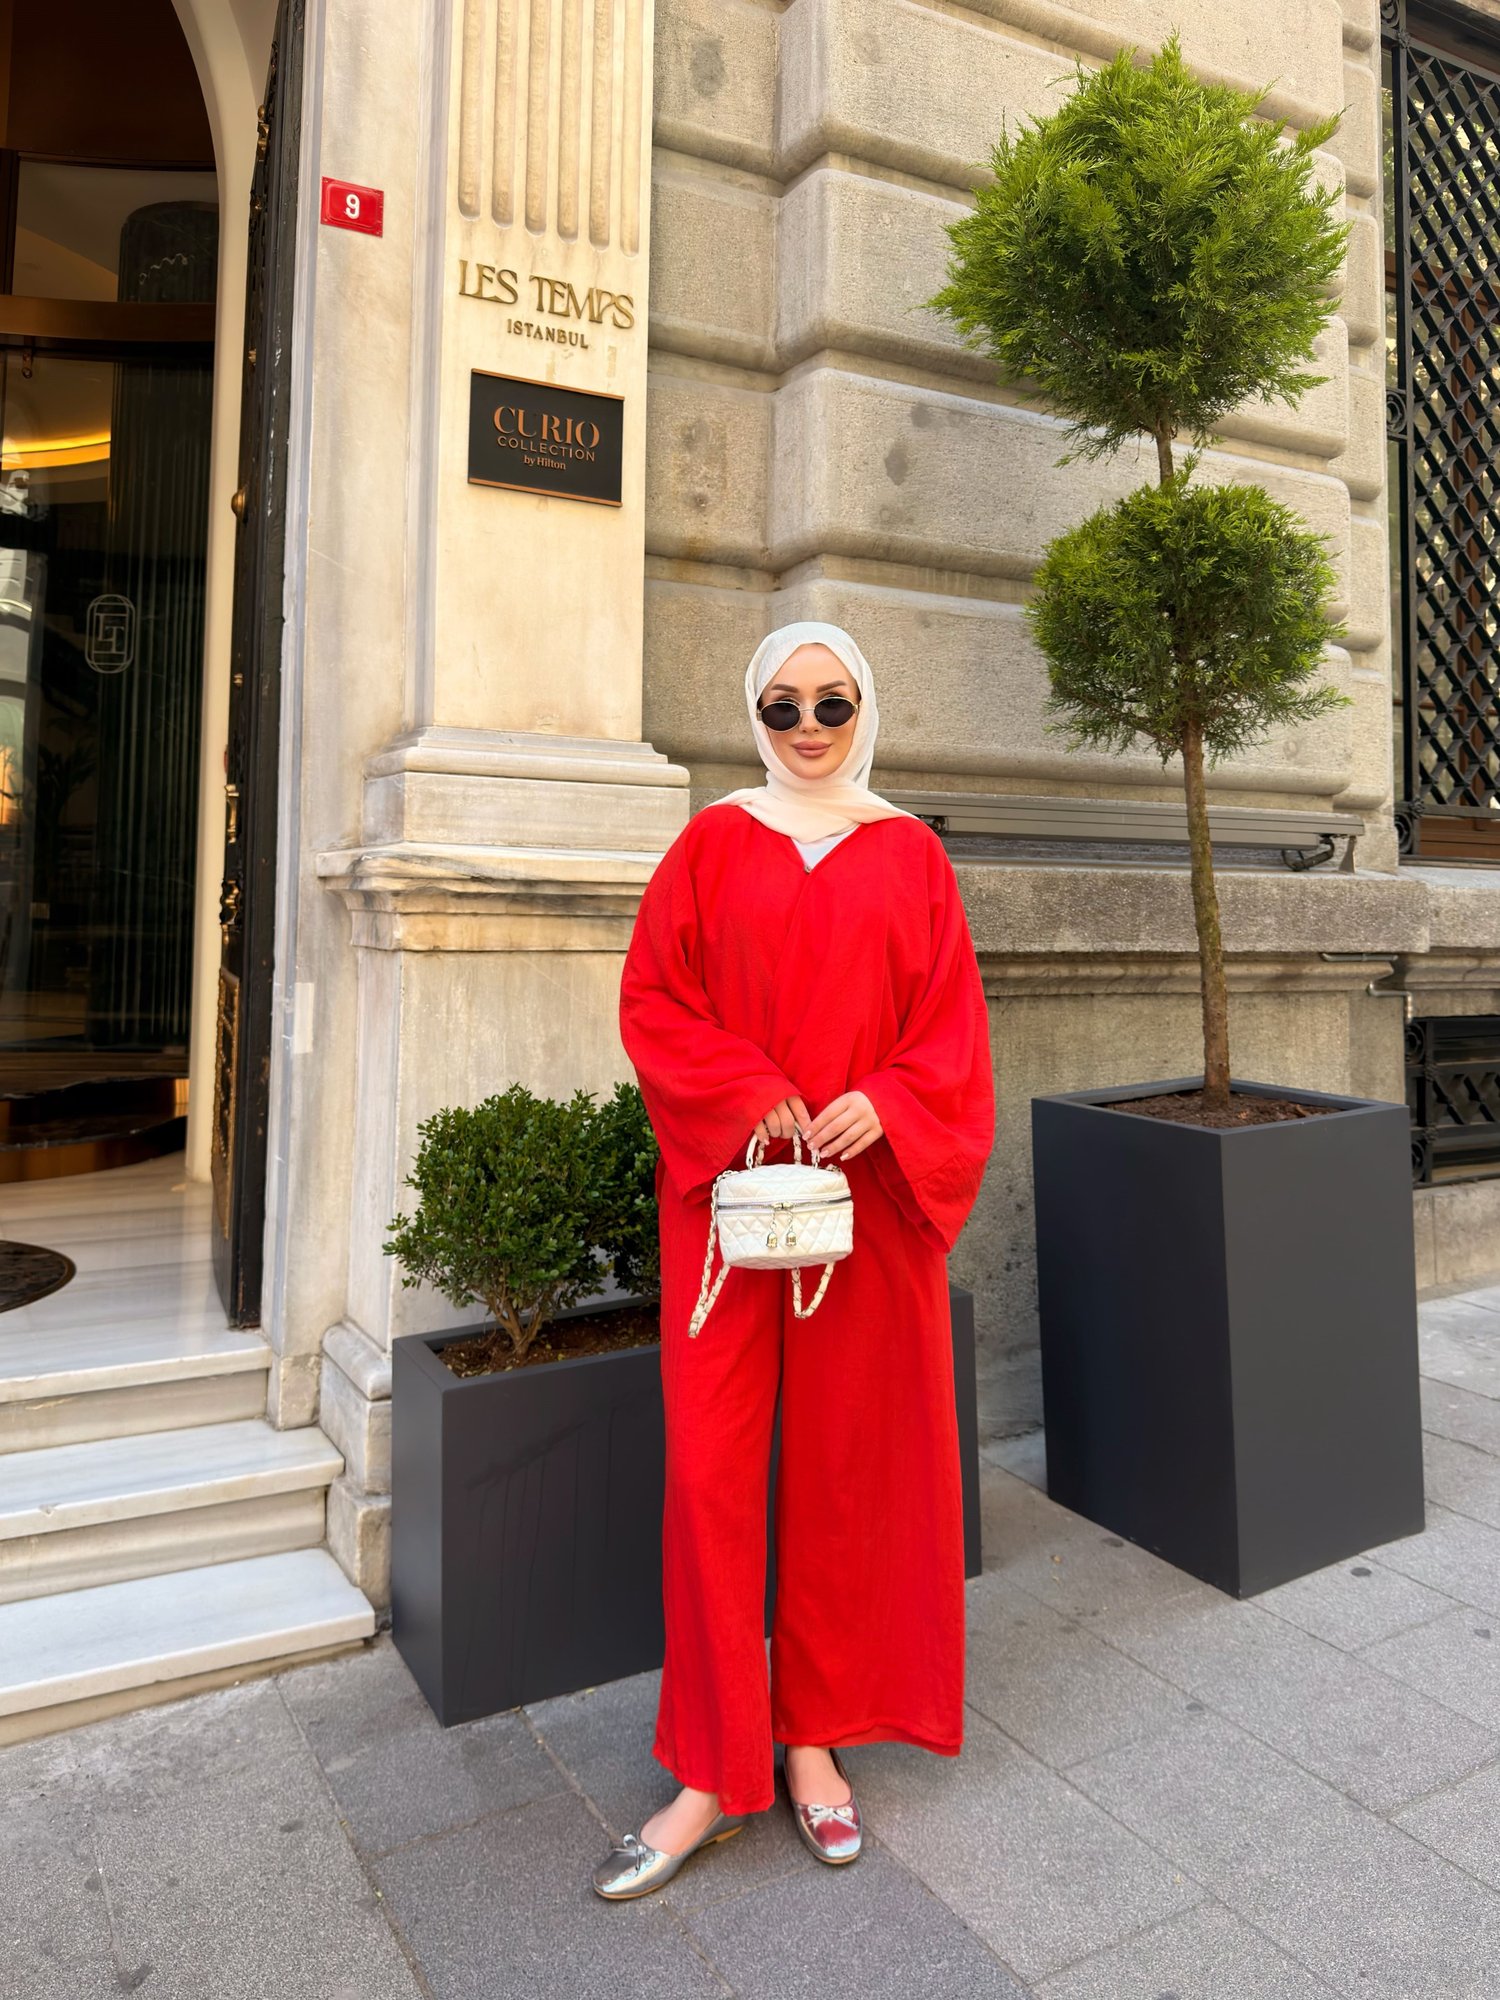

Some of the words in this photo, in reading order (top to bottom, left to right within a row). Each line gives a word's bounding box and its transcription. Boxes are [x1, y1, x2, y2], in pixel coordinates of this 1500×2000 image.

[344, 193, 361, 220] 9
[458, 259, 519, 305] LES
[529, 275, 635, 329] TEMPS
[507, 318, 589, 349] ISTANBUL
[493, 405, 600, 449] CURIO
[497, 435, 596, 462] COLLECTION
[523, 454, 536, 467] by
[537, 456, 567, 471] Hilton
